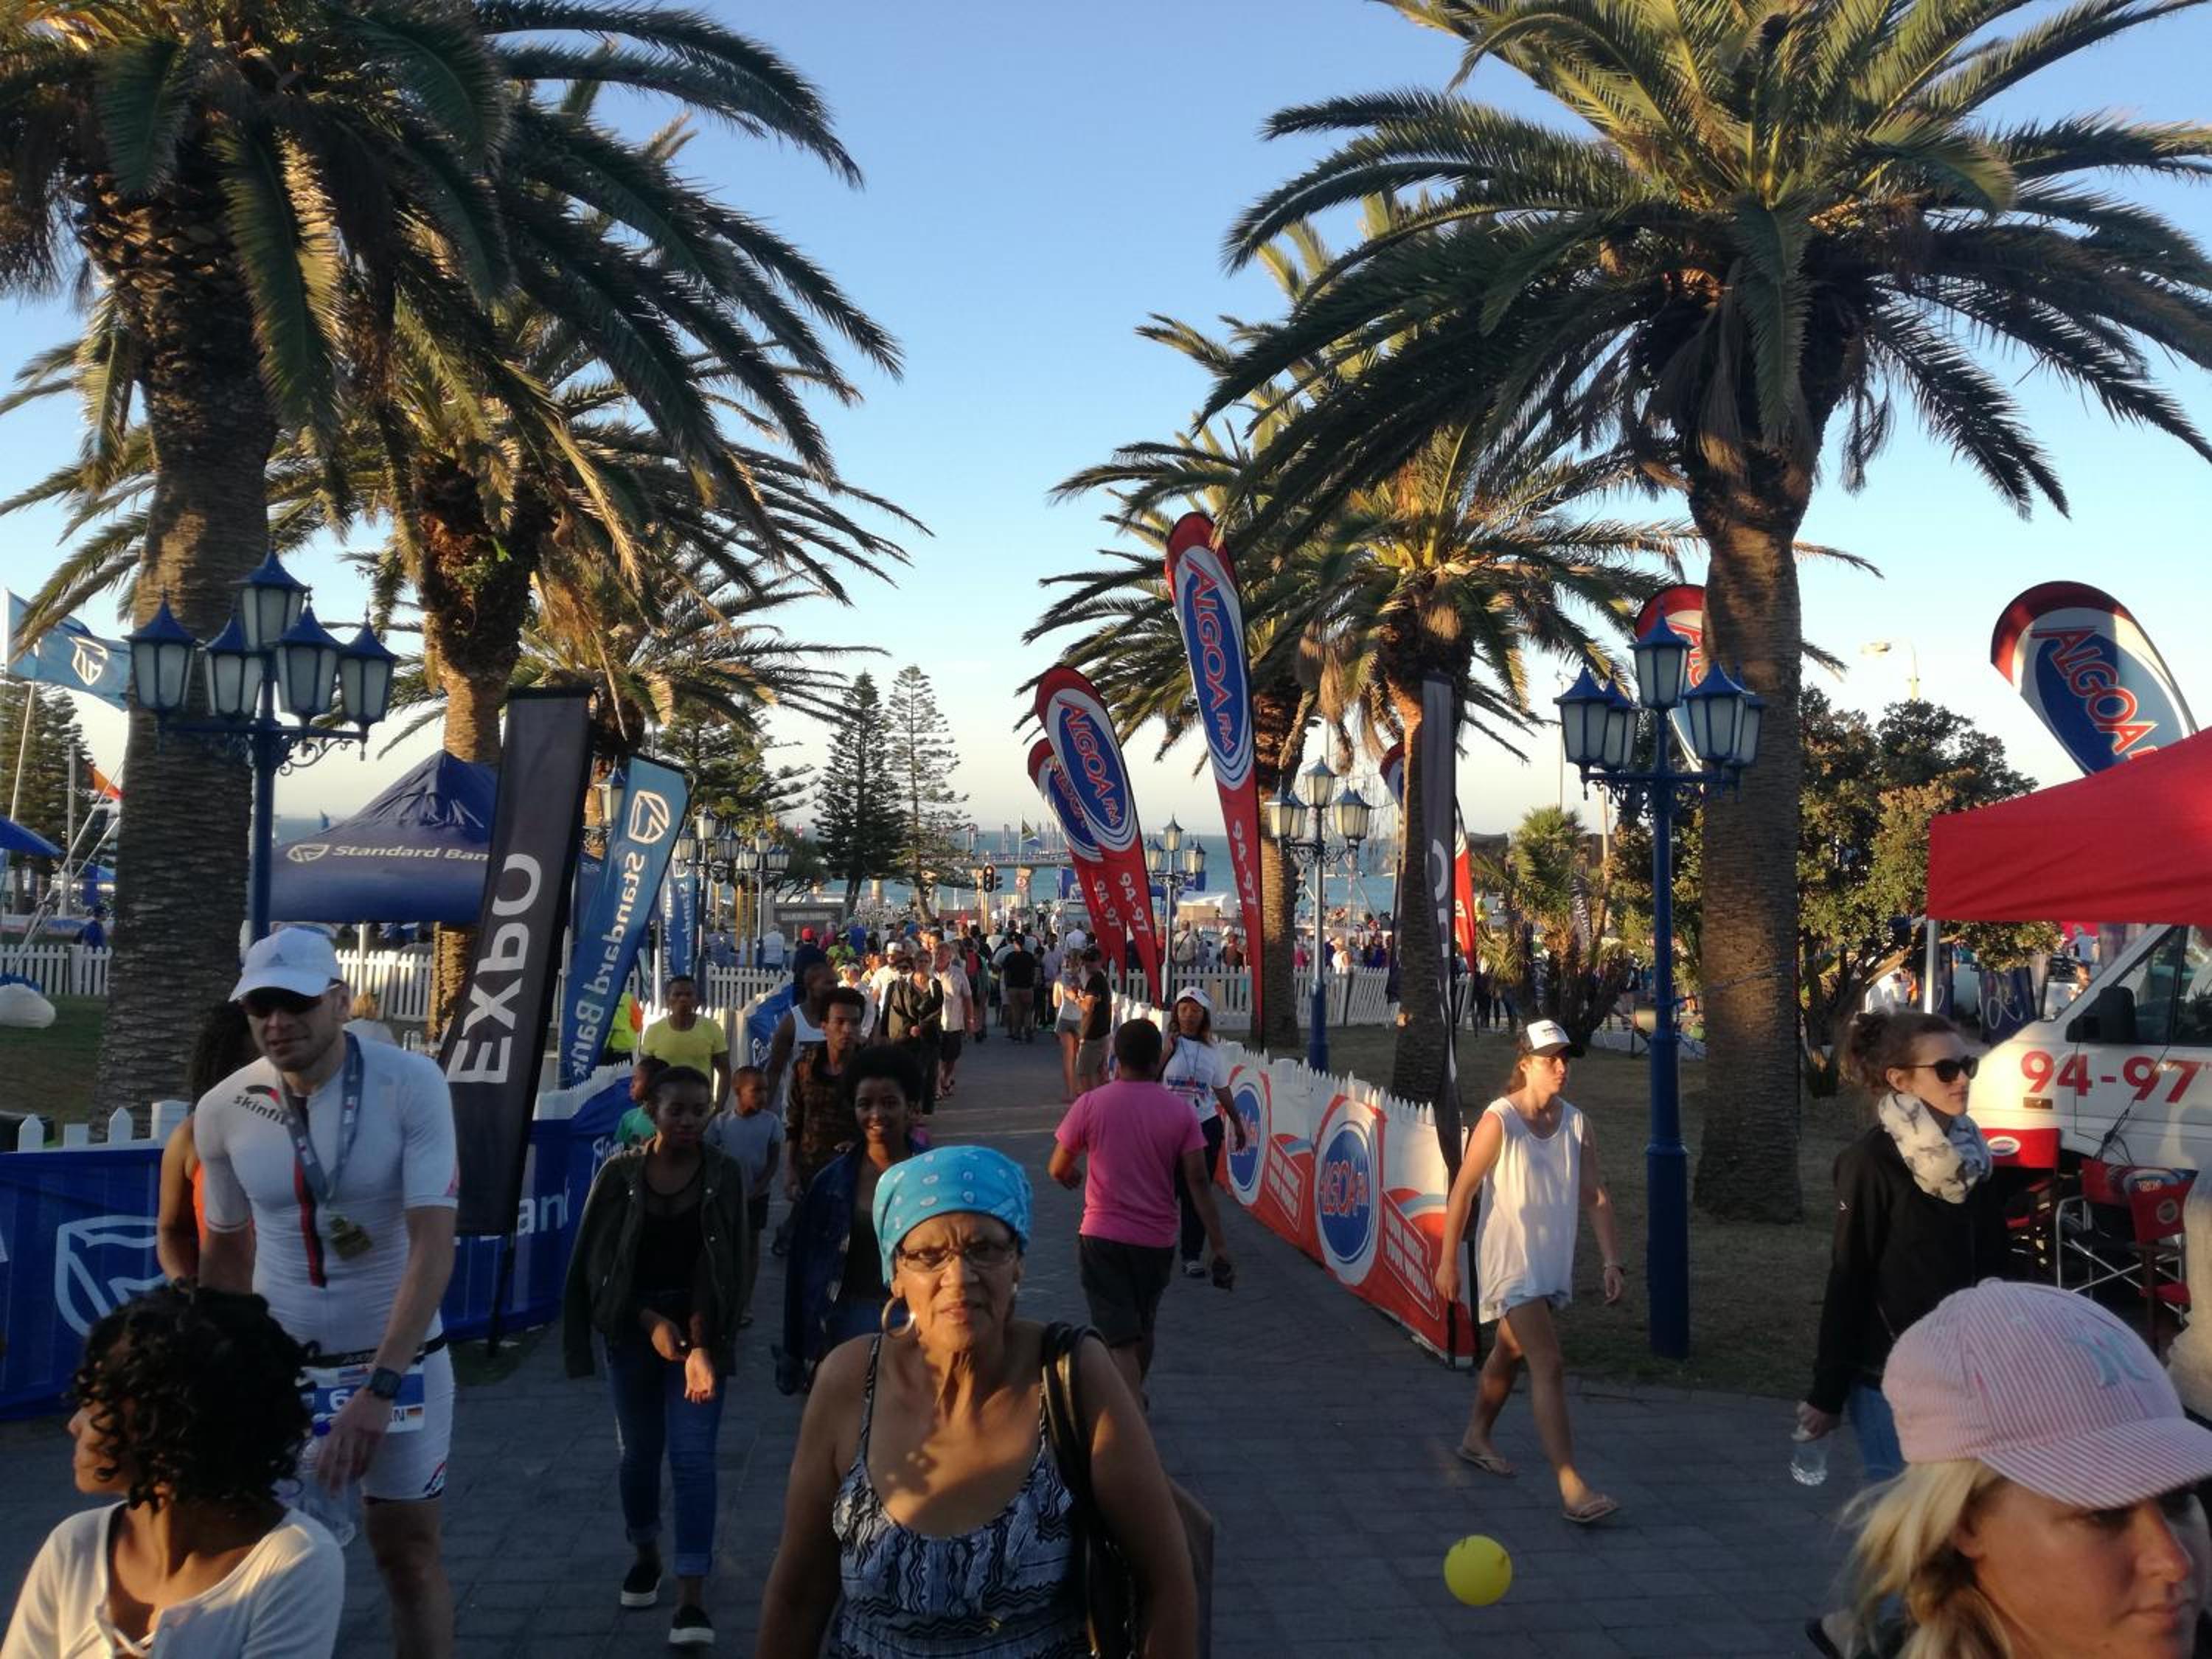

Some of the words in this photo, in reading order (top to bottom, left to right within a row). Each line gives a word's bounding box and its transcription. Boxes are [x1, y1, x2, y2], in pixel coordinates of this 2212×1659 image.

[1184, 555, 1232, 712] ALGOA
[1217, 713, 1236, 753] FM
[2029, 627, 2159, 755] ALGOA
[1057, 696, 1115, 799] ALGOA
[1102, 798, 1121, 827] FM
[332, 845, 442, 858] Standard
[445, 847, 490, 861] Ban
[1120, 873, 1150, 932] 94-97
[2021, 1051, 2202, 1103] 94-97
